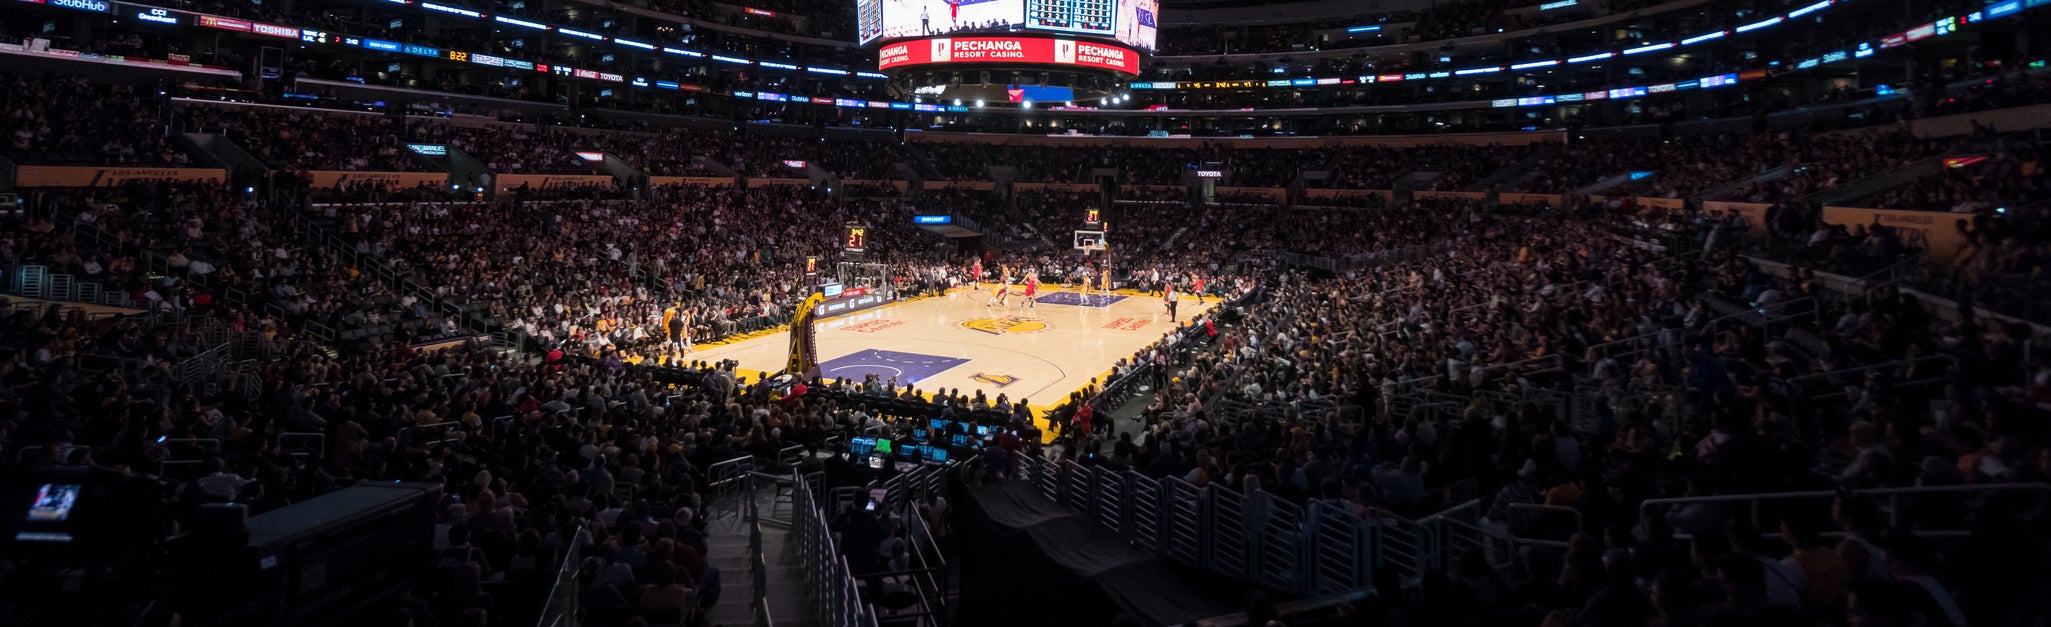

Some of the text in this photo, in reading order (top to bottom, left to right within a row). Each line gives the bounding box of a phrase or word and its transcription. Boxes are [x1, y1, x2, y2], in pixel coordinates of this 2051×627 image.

[254, 25, 298, 38] TOSHIBA
[954, 41, 1022, 51] PECHANGA
[412, 47, 438, 56] DELTA
[1078, 45, 1124, 60] PECHANGA
[473, 55, 502, 66] STAPLES
[1078, 55, 1103, 63] RESORT
[600, 73, 623, 82] TOYOTA
[849, 235, 862, 247] 21
